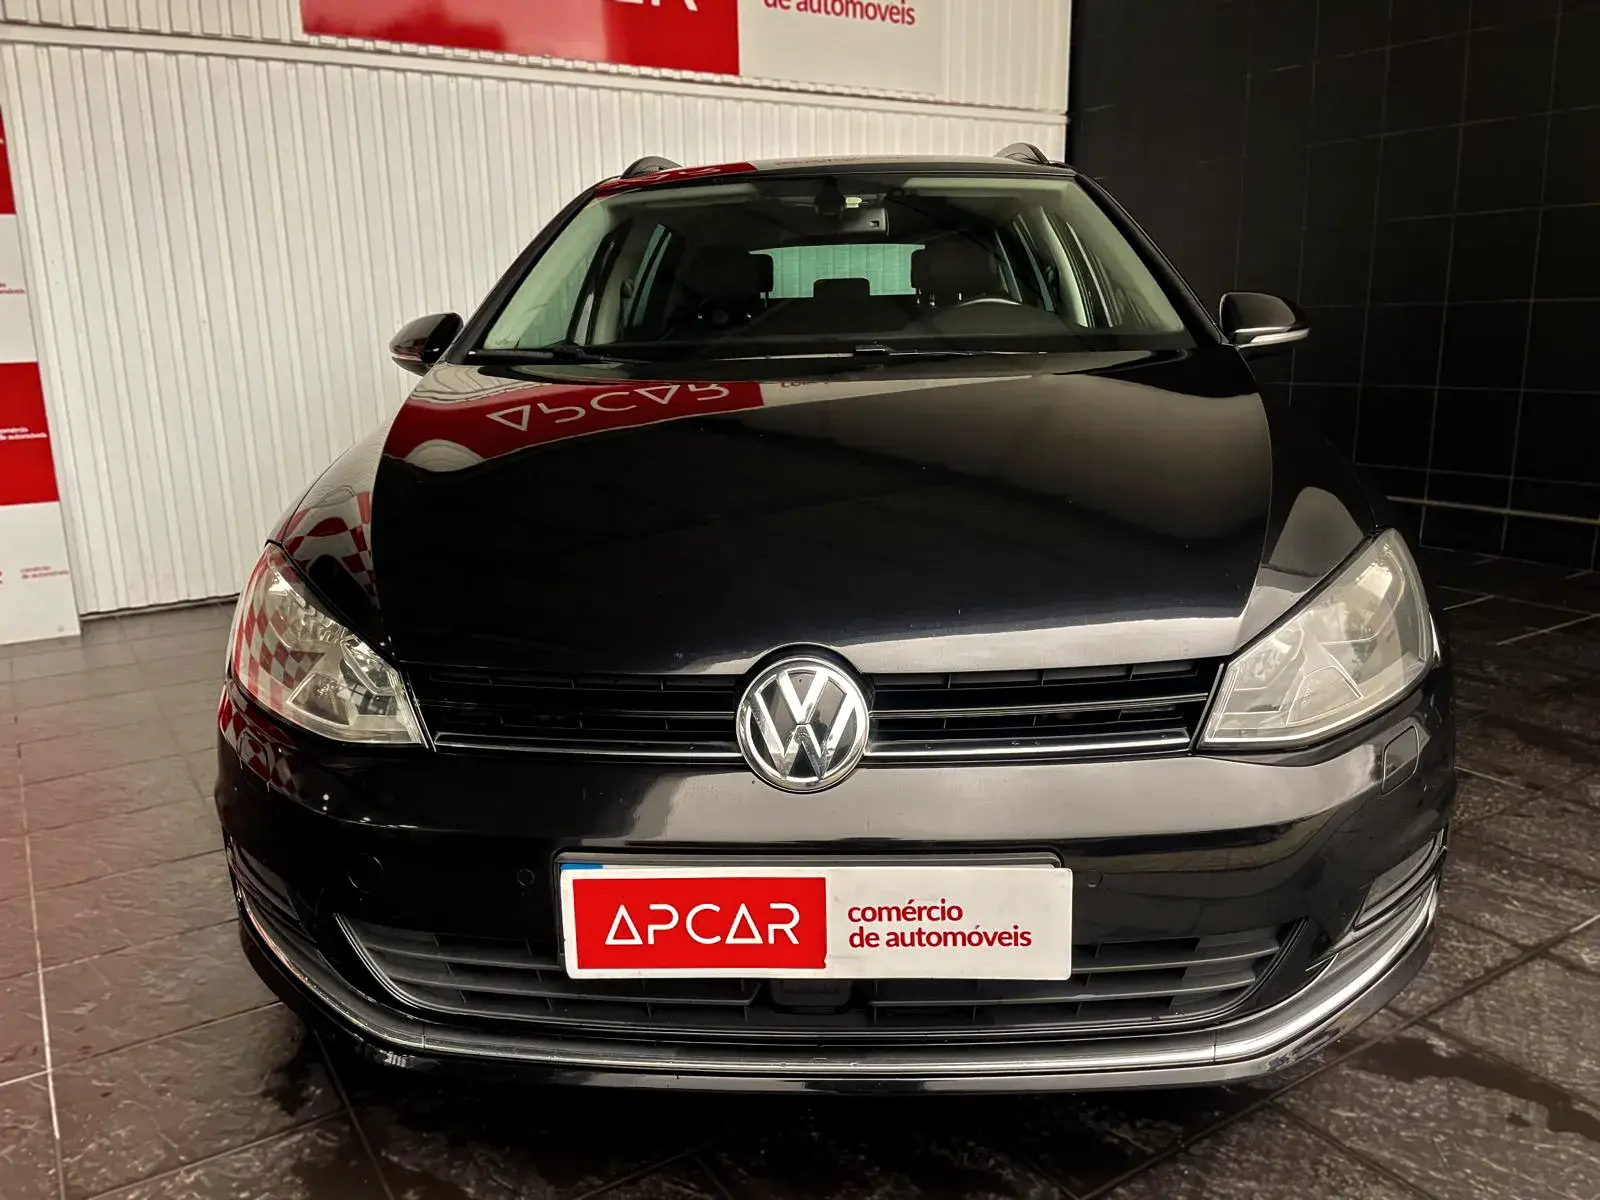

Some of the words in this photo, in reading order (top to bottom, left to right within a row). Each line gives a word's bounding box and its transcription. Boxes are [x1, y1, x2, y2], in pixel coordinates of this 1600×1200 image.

[847, 898, 964, 923] comércio
[604, 902, 801, 946] APCAR
[849, 926, 881, 948] de
[885, 925, 1033, 948] automóveis
